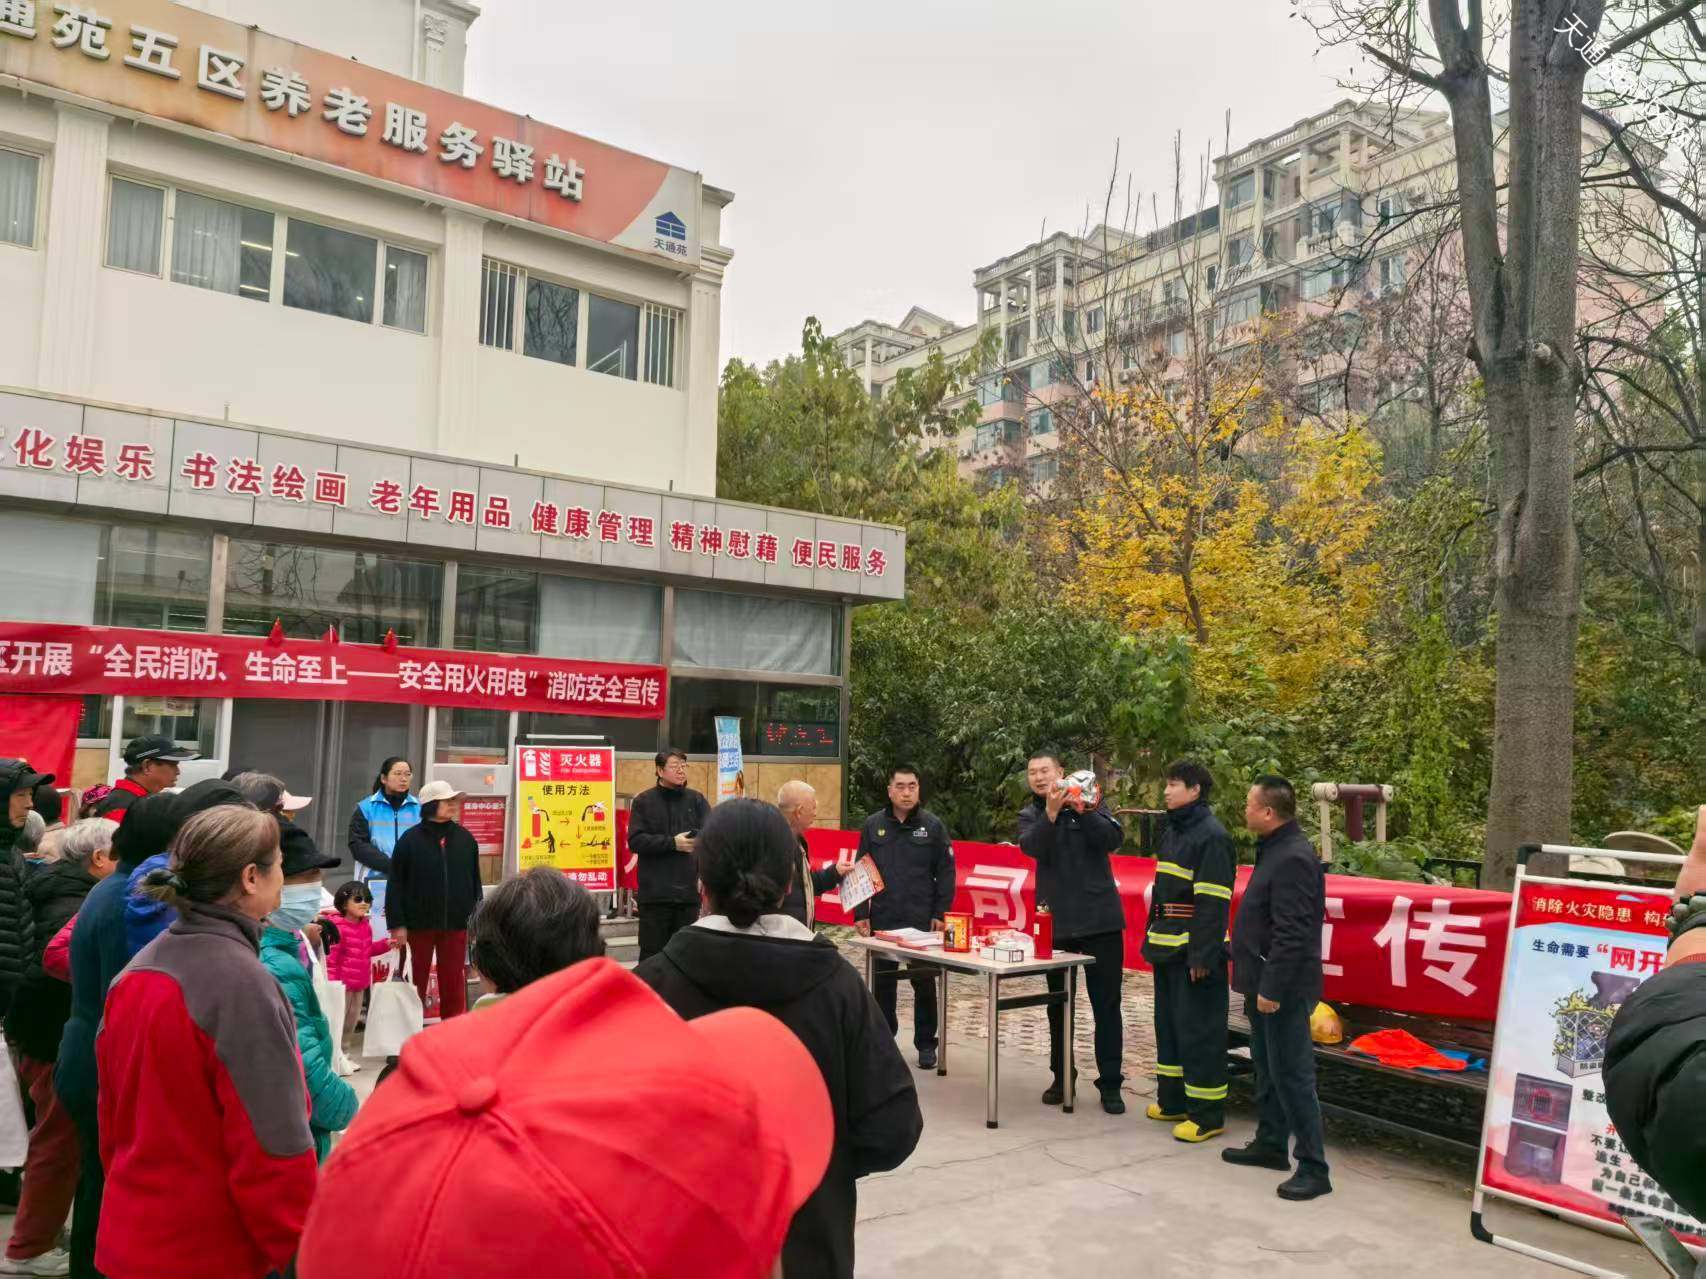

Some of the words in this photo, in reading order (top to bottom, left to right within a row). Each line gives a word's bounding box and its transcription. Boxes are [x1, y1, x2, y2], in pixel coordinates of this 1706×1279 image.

[653, 237, 688, 257] 天通苑
[0, 427, 155, 480] 化娱乐
[181, 452, 349, 507] 书法绘画
[369, 479, 511, 529] 老年用品
[531, 500, 655, 548] 健康管理
[670, 520, 778, 564] 精神慰藉
[790, 538, 887, 577] 便民服务
[560, 752, 602, 768] 灭火器
[542, 784, 592, 796] 使用方法
[1532, 896, 1633, 923] 消除火灾隐患
